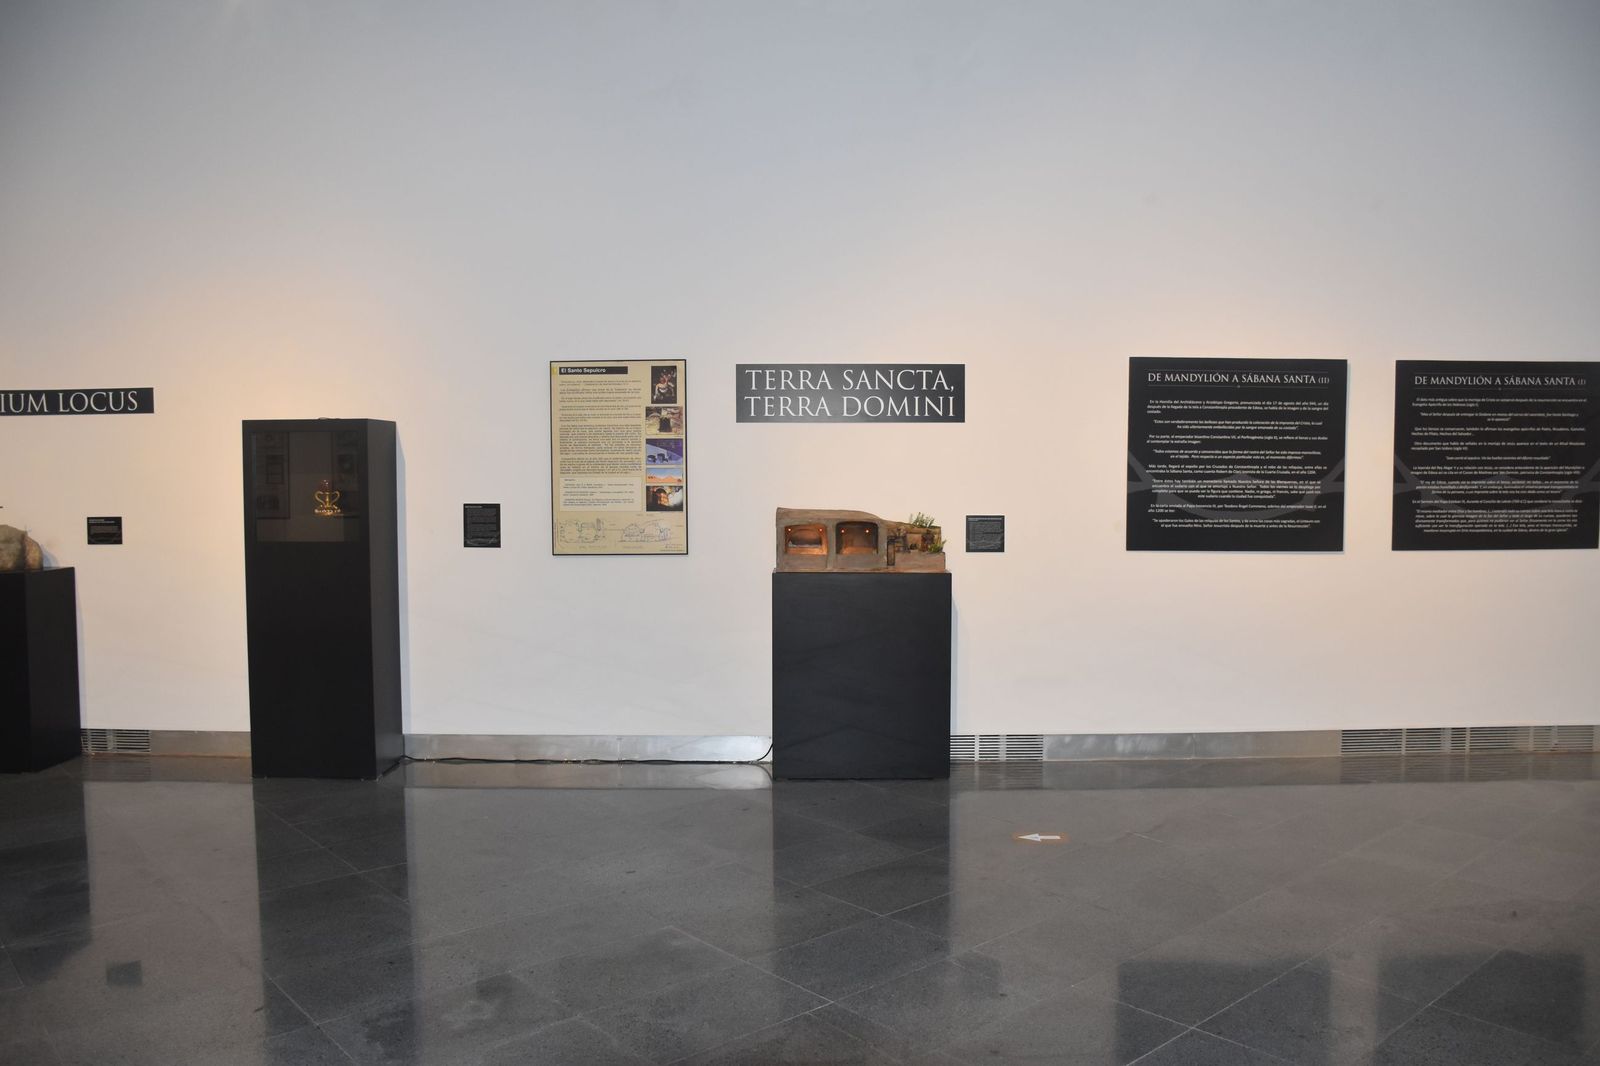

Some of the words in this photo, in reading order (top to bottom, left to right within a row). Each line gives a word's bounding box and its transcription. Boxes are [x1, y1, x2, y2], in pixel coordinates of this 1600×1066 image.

[745, 369, 833, 391] TERRA
[842, 369, 955, 392] SANCTA,
[1148, 372, 1162, 382] DE
[1164, 372, 1229, 383] MANDYLIÓN
[1232, 373, 1239, 383] A
[1241, 373, 1281, 383] SÁBANA
[1283, 374, 1316, 384] SANTA
[1318, 376, 1330, 384] (II)
[1414, 376, 1427, 385] DE
[1429, 375, 1492, 385] MANDYLIÓN
[1495, 376, 1502, 385] A
[1504, 375, 1542, 385] SÁBANA
[1544, 376, 1576, 386] SANTA
[58, 390, 138, 413] LOCUS
[744, 396, 832, 417] TERRA
[842, 396, 956, 417] DOMINI
